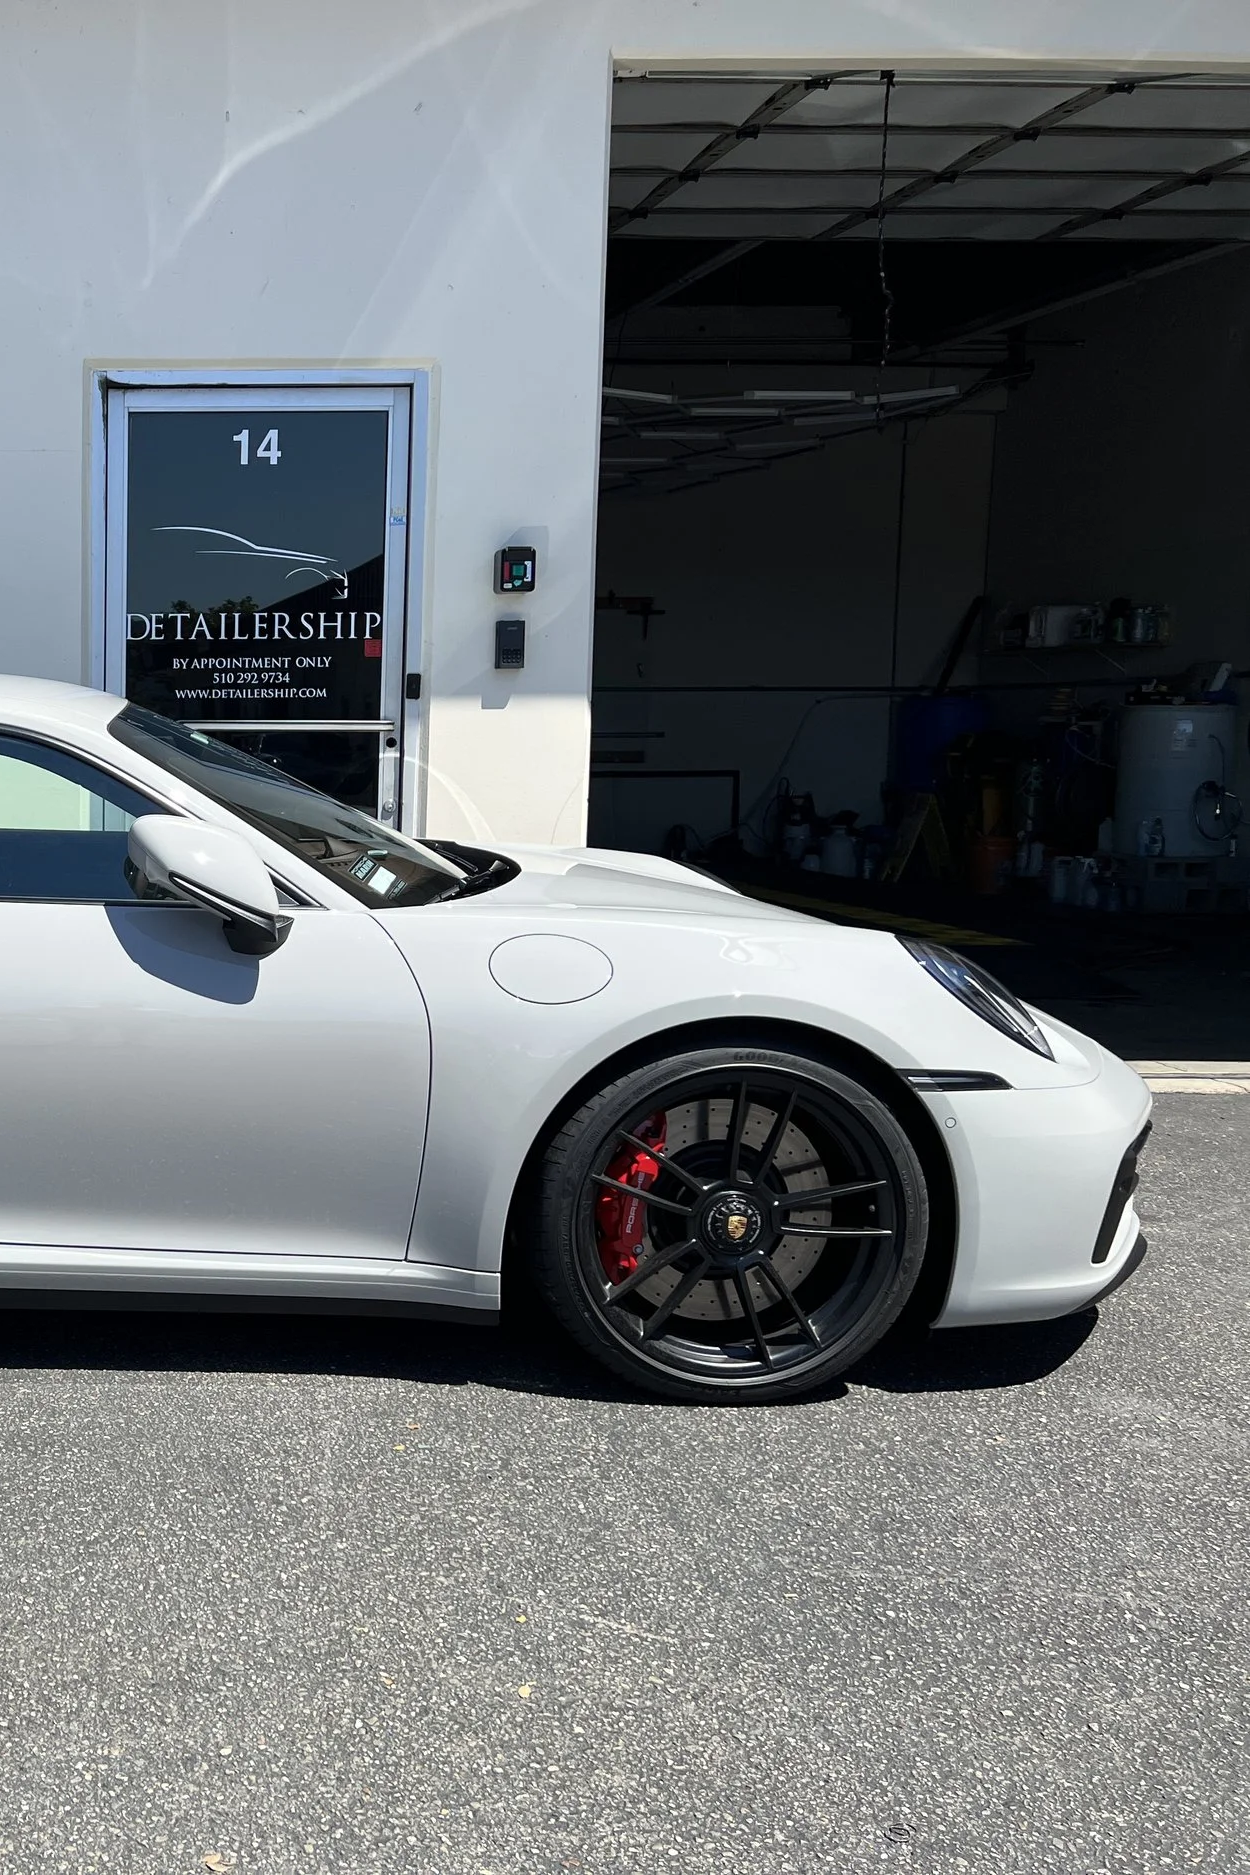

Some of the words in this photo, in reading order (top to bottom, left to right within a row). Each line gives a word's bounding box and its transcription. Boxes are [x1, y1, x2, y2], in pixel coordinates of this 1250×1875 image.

[232, 429, 282, 465] 14
[126, 611, 382, 641] DETAILERSHIP
[173, 658, 189, 670] BY
[191, 657, 291, 670] APPOINTMENT
[295, 656, 332, 669] ONLY
[212, 673, 235, 684] 510
[236, 673, 259, 684] 292
[261, 672, 290, 684] 9734
[175, 687, 327, 699] WWW.DETAILERSHIP.COM
[625, 1171, 646, 1234] PORSHE
